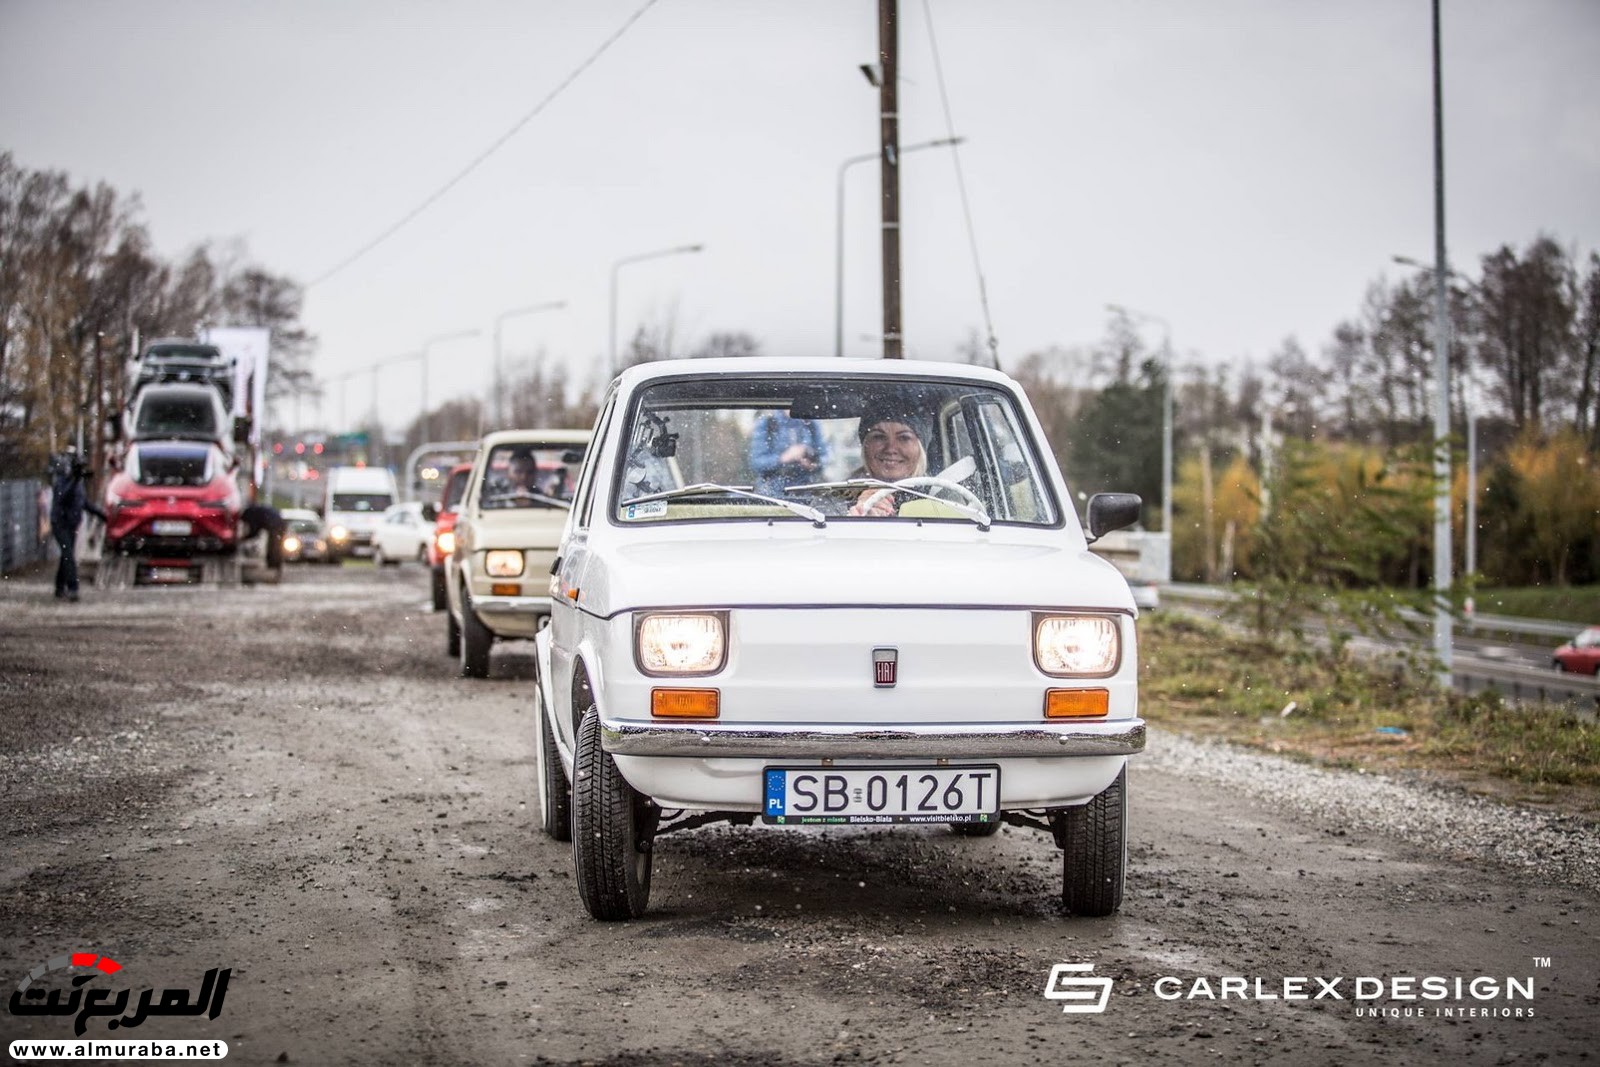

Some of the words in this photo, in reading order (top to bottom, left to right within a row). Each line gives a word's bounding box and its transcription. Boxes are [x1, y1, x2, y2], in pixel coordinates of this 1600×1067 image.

[877, 662, 894, 682] FIAT
[793, 775, 848, 812] SB
[867, 773, 991, 811] 0126T
[769, 799, 783, 809] PL
[909, 814, 972, 823] www.visitbielsko.pl
